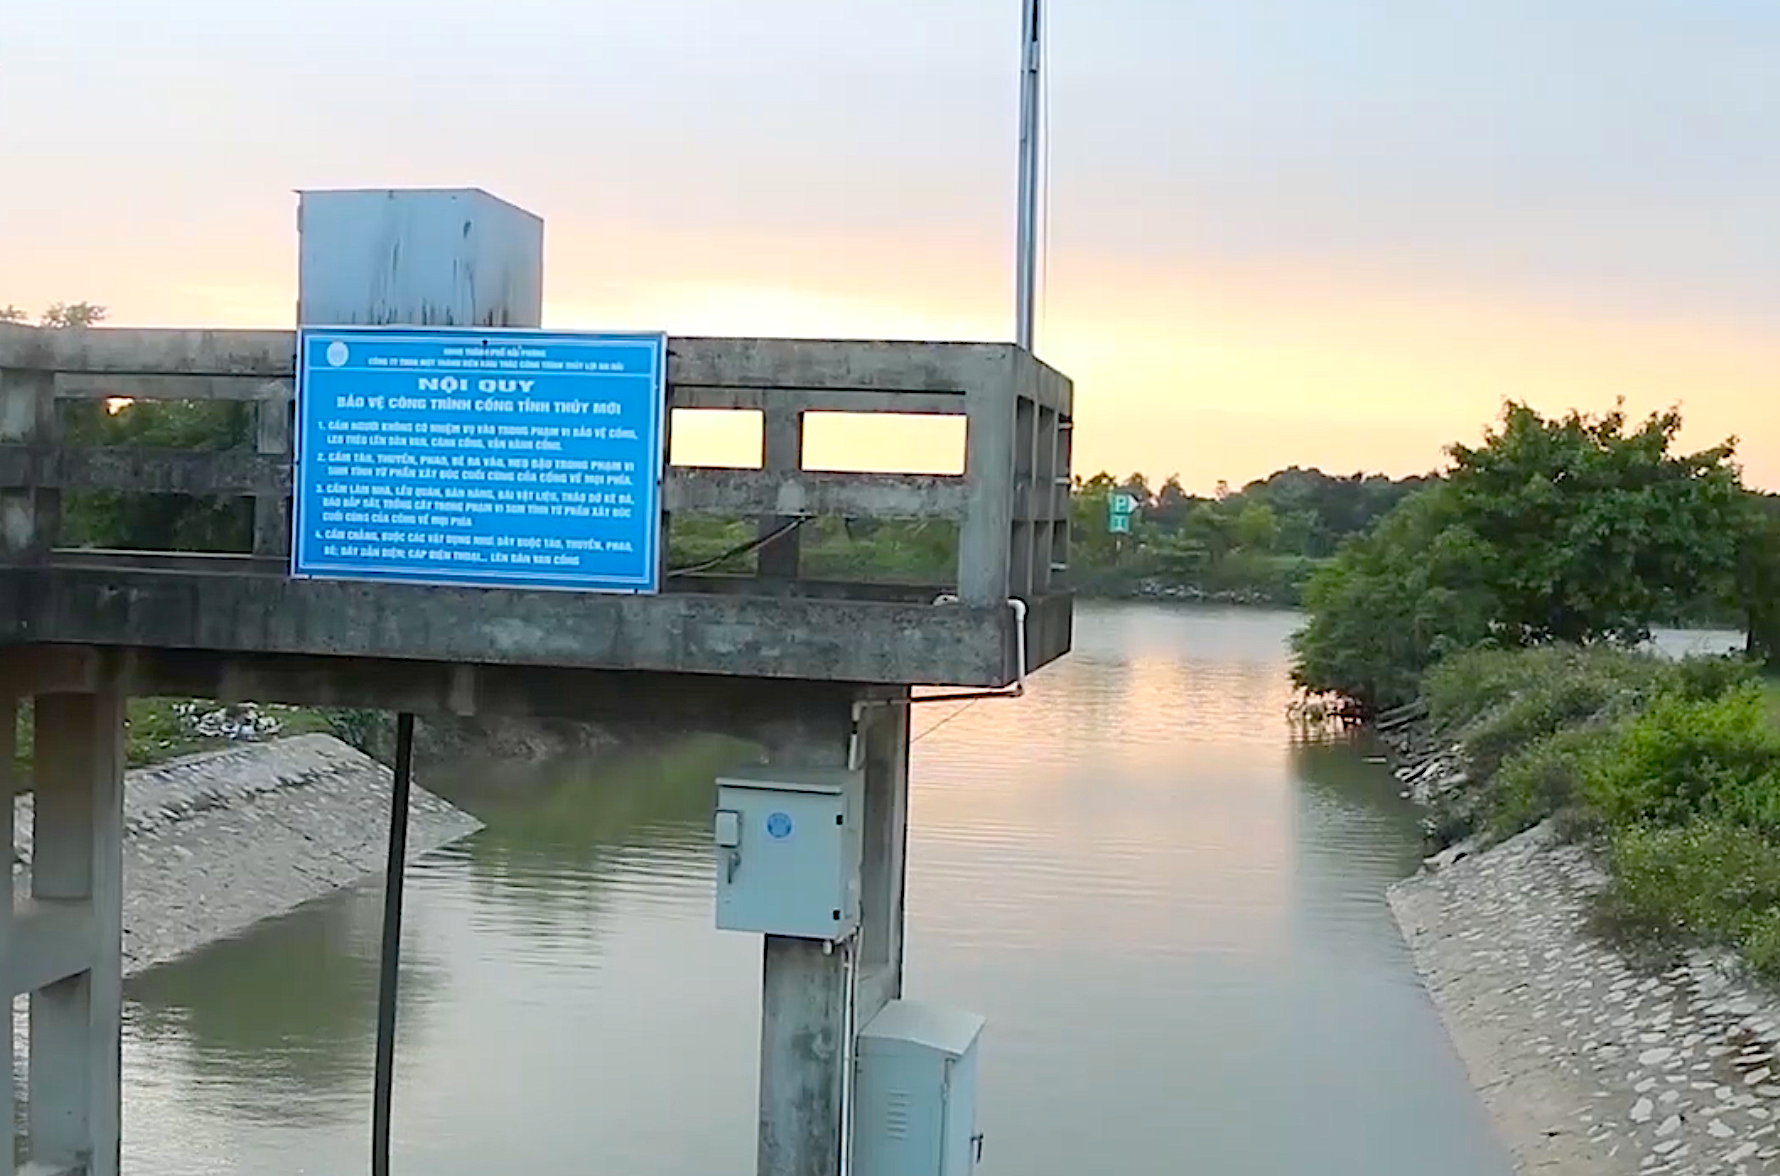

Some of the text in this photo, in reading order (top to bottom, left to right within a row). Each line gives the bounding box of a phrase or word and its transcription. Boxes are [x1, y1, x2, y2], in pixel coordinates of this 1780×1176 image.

[418, 376, 535, 393] NỘI QUY
[337, 394, 364, 408] BẢO
[368, 396, 385, 410] VỆ
[388, 396, 427, 409] CÔNG
[317, 421, 326, 430] 1.
[317, 453, 325, 461] 2.
[1116, 495, 1127, 512] P
